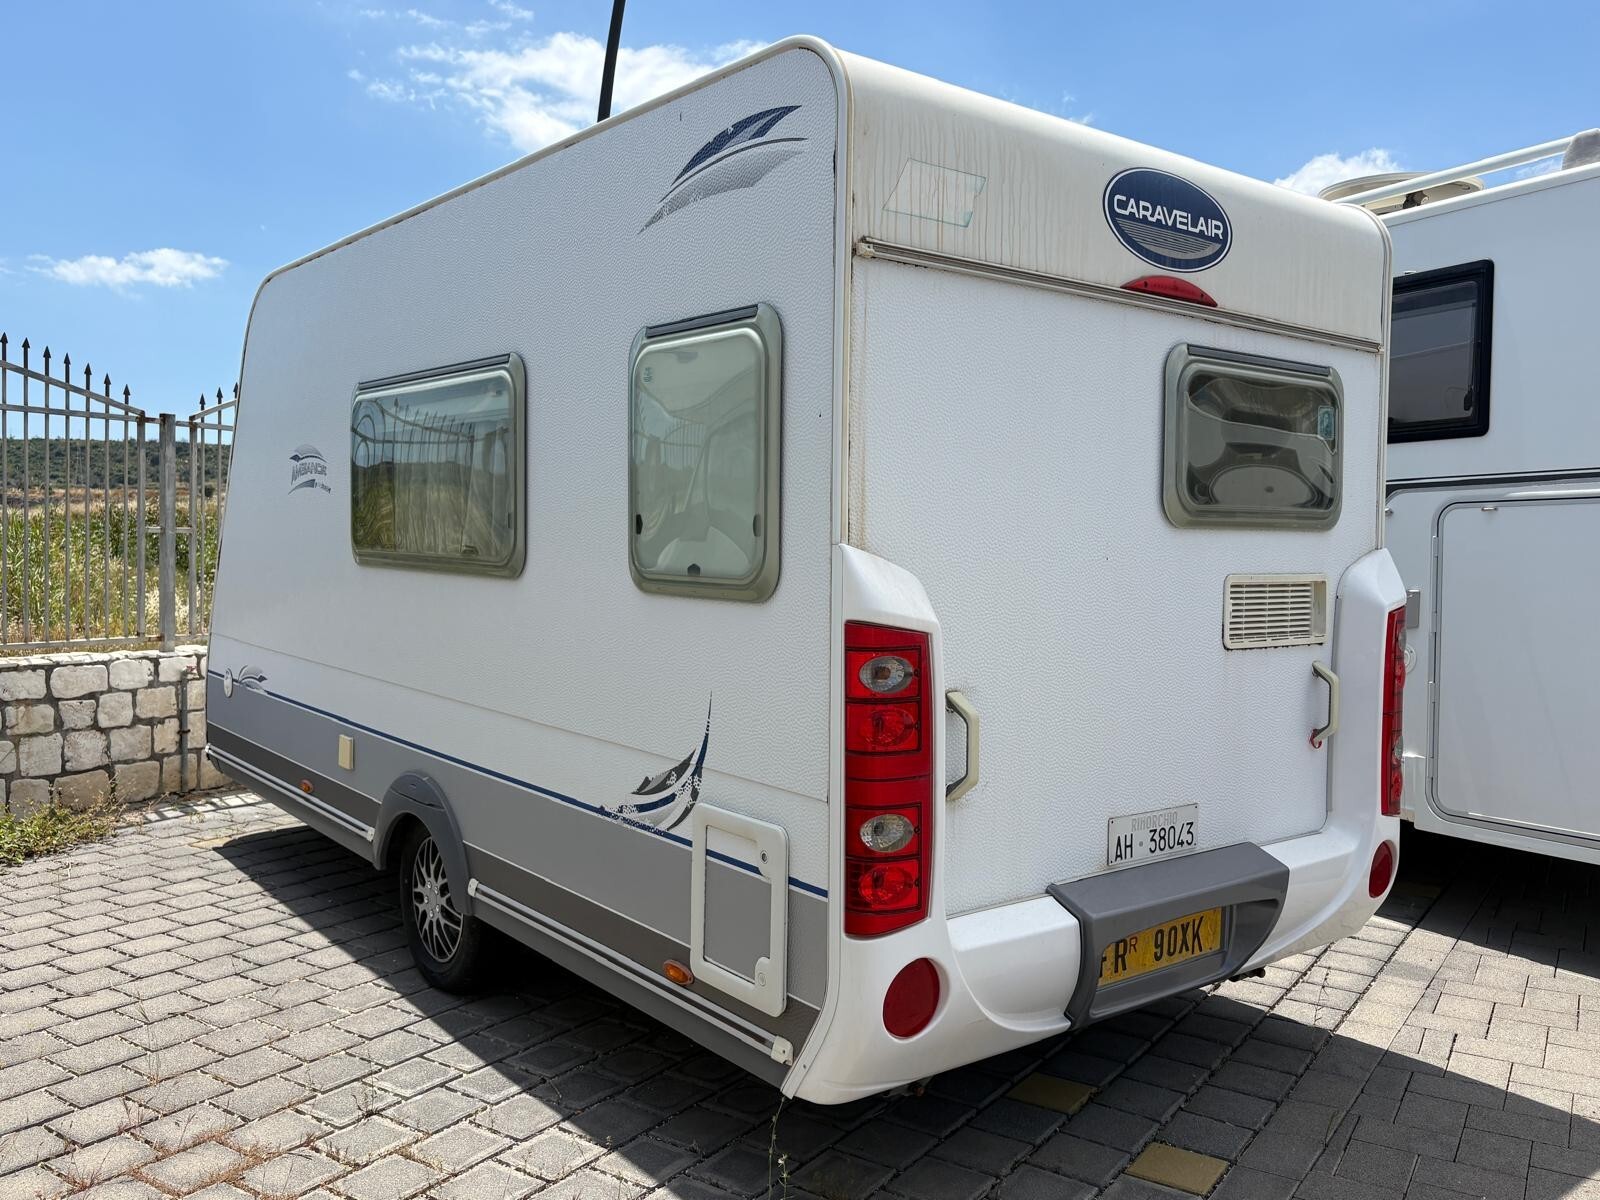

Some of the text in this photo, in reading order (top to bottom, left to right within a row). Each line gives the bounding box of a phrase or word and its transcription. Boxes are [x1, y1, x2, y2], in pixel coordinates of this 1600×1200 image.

[1113, 194, 1224, 240] CARAVELAIR
[1114, 820, 1195, 863] AH 38043
[1153, 915, 1205, 962] 90XK
